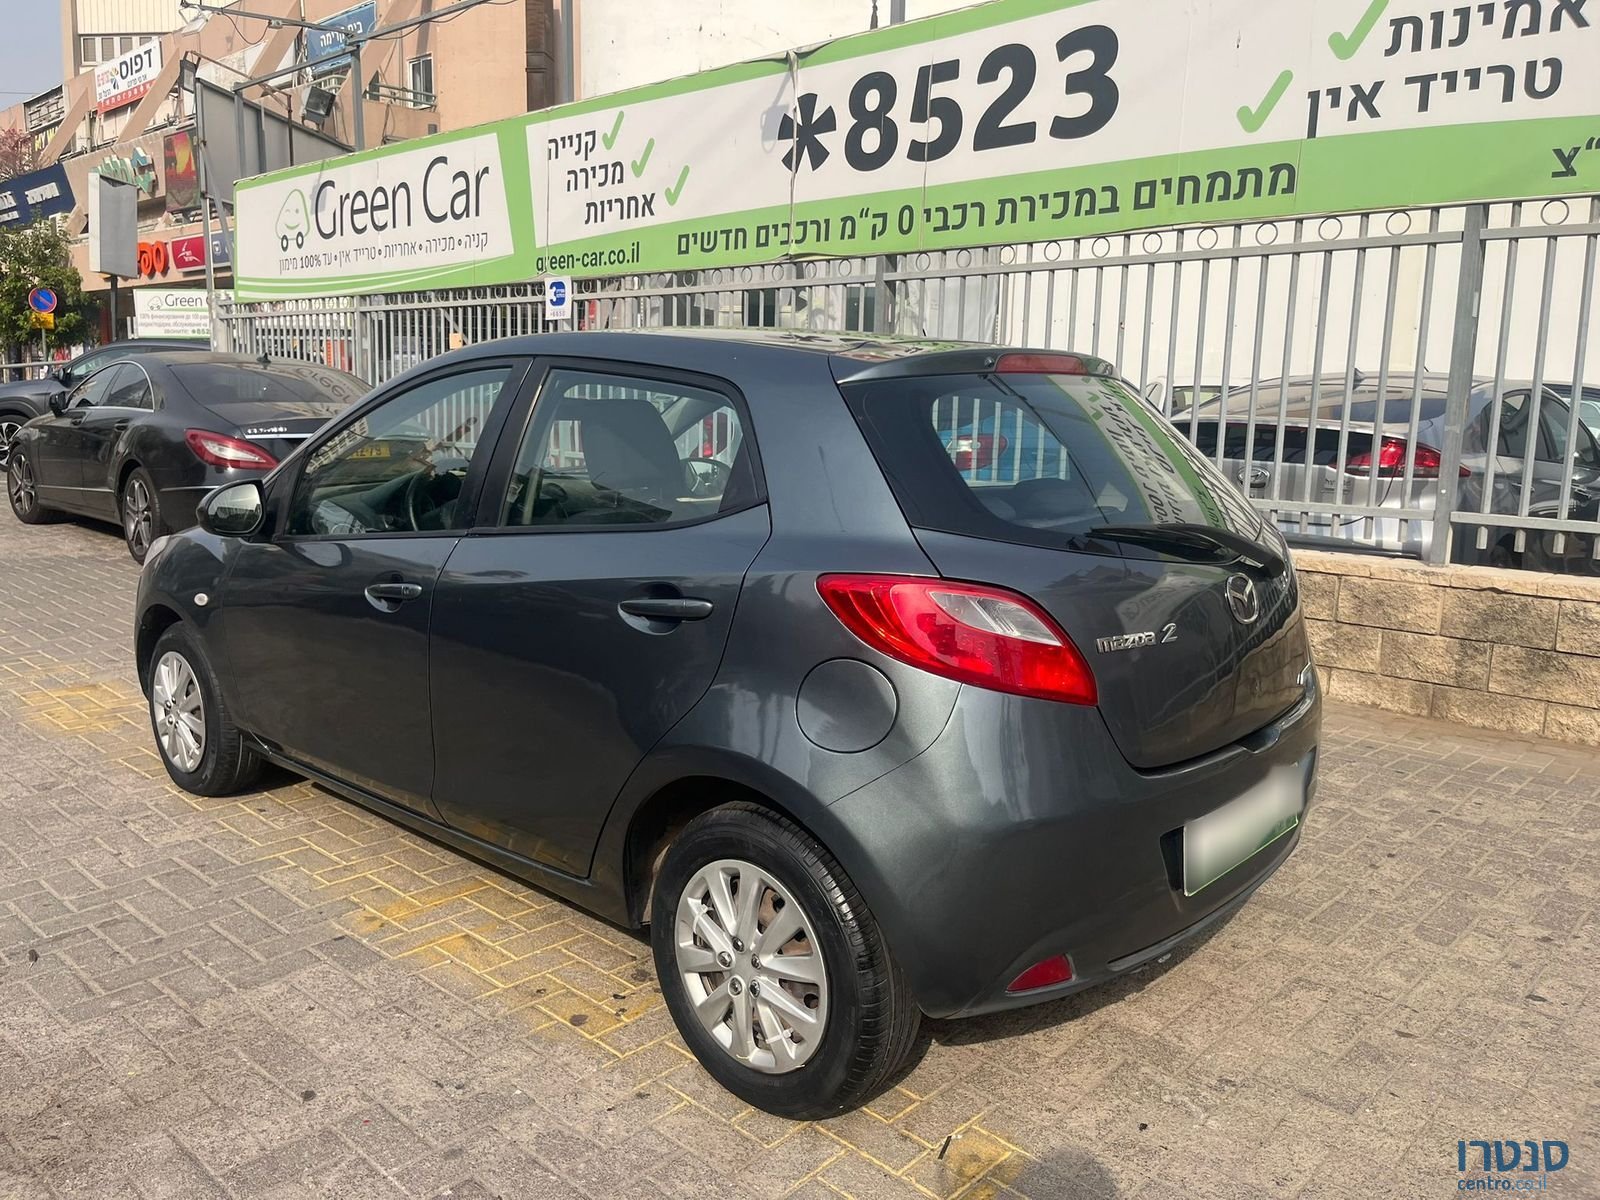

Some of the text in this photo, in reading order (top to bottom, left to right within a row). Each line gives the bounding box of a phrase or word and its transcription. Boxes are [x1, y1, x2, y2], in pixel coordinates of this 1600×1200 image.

[120, 48, 152, 80] דפוס
[1306, 57, 1563, 139] טרייד אין
[548, 129, 597, 160] קנייה
[566, 160, 624, 192] מכירה
[1134, 162, 1297, 212] מתמחים
[315, 156, 490, 240] Green Car
[584, 192, 656, 225] אחריות
[995, 184, 1120, 226] במכירת
[922, 200, 986, 234] רכבי
[279, 232, 488, 275] קניה מכירה אחריות טרייד אין עד 100% מימון
[677, 227, 747, 255] חדשים
[536, 241, 640, 275] green-car.co.il
[164, 293, 203, 307] Green
[1160, 622, 1178, 644] 2
